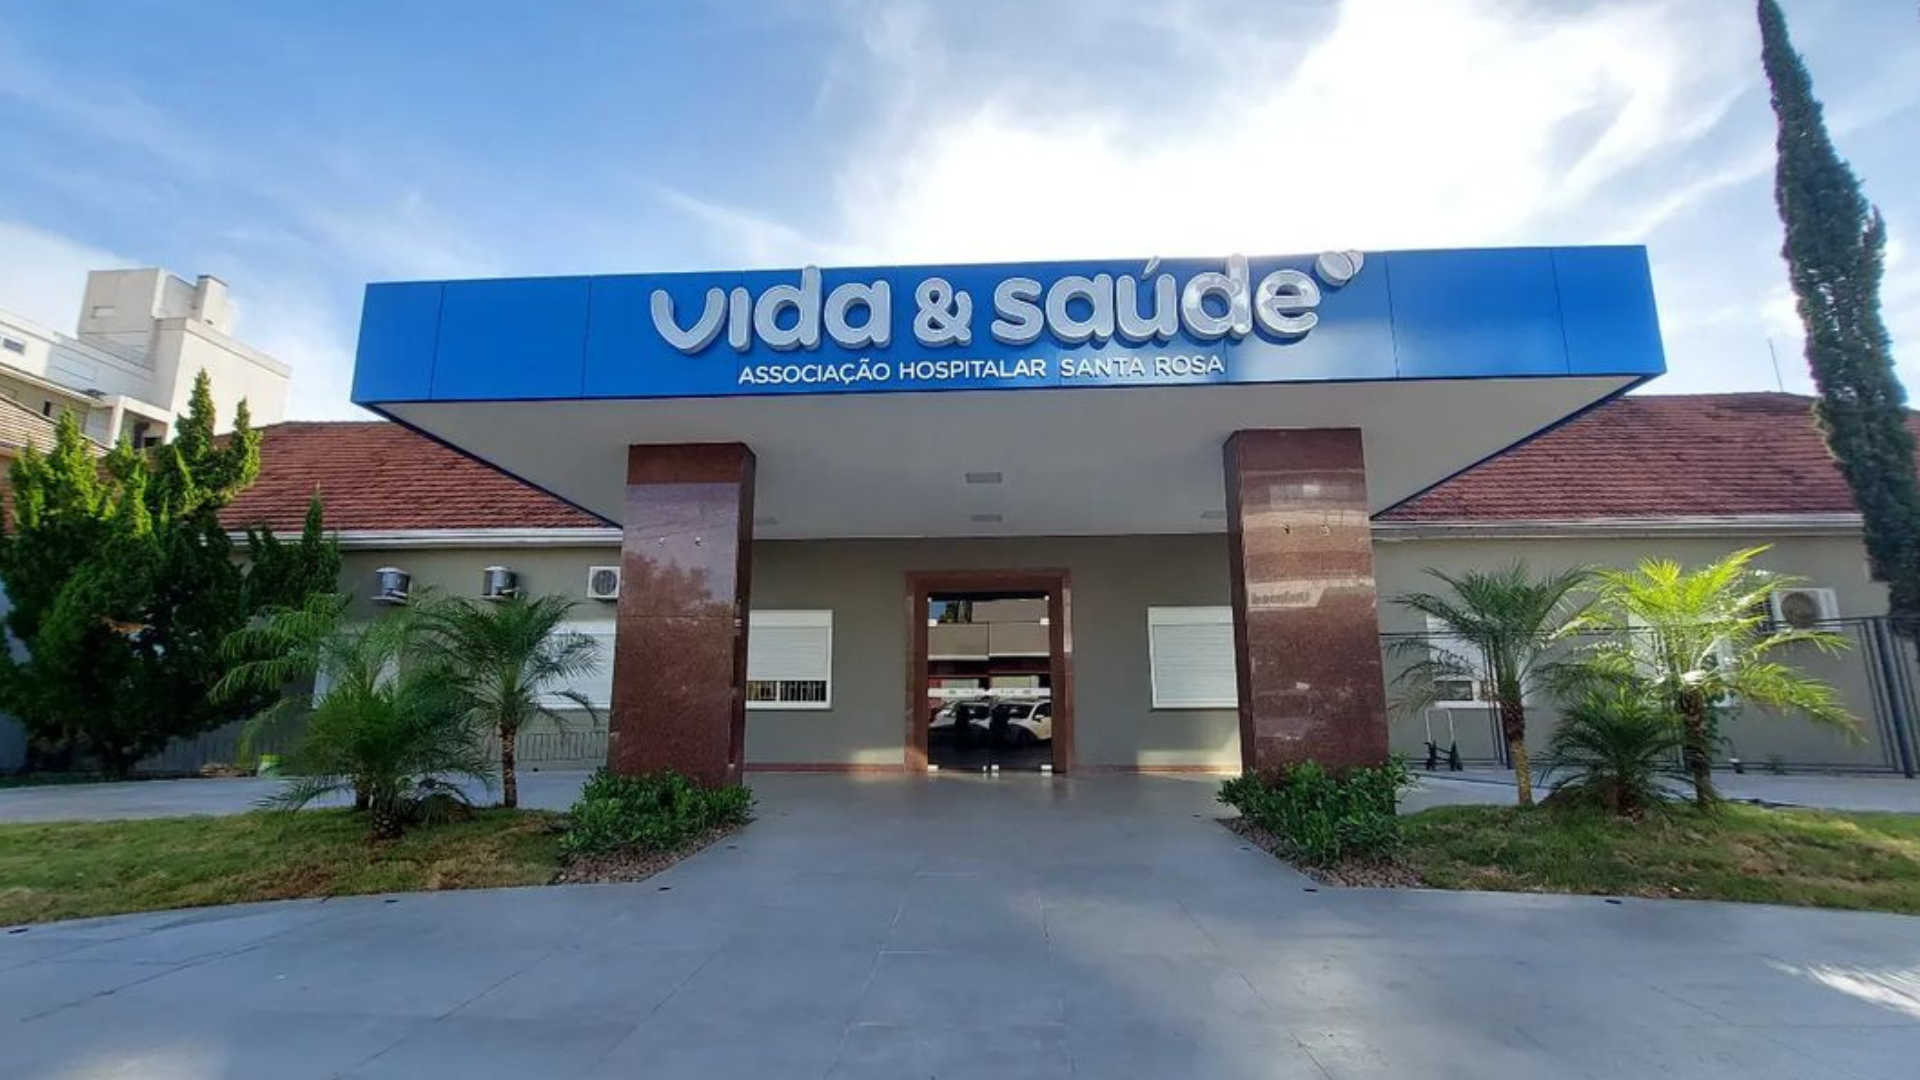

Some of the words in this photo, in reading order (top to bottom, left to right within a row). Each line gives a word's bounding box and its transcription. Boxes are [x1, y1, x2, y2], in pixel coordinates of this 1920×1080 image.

[913, 277, 973, 347] &
[990, 253, 1322, 346] saúde
[738, 358, 891, 385] ASSOCIAÇÃO
[899, 357, 1047, 380] HOSPITALAR
[1059, 357, 1146, 379] SANTA
[1153, 355, 1225, 377] ROSA
